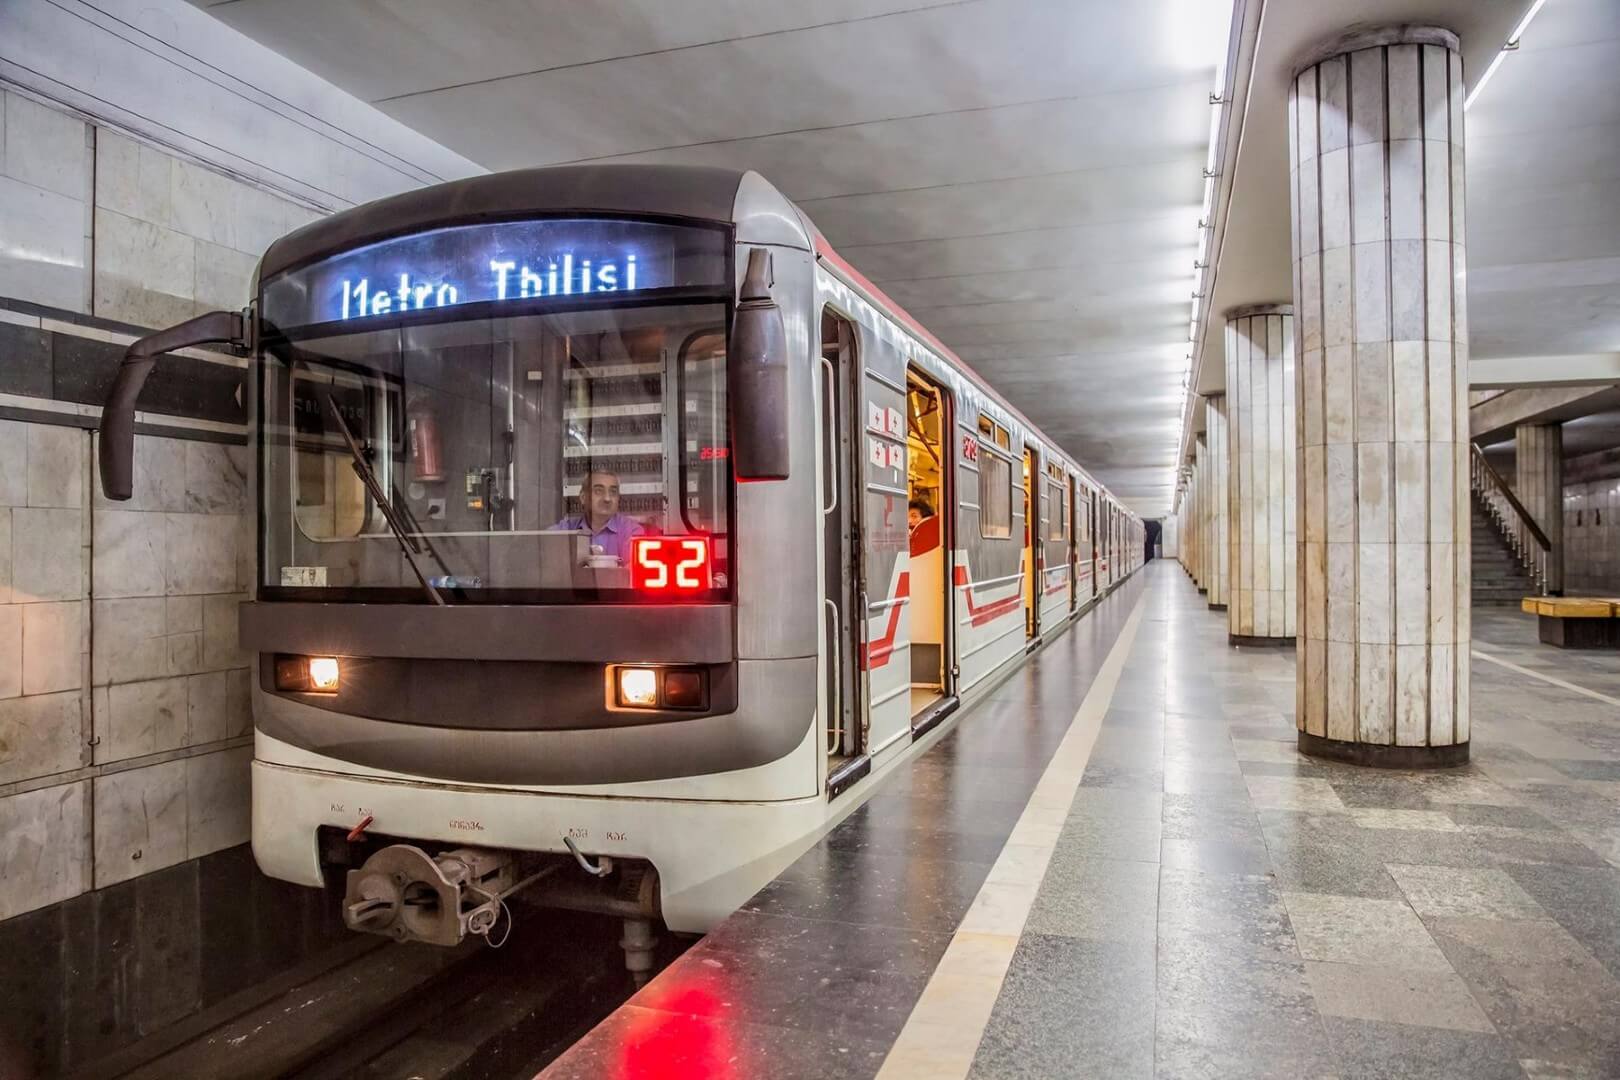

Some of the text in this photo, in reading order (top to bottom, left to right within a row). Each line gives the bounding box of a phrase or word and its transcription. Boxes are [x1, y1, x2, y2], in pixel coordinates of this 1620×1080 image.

[342, 253, 637, 320] Metro Tbilisi
[638, 540, 705, 588] 52
